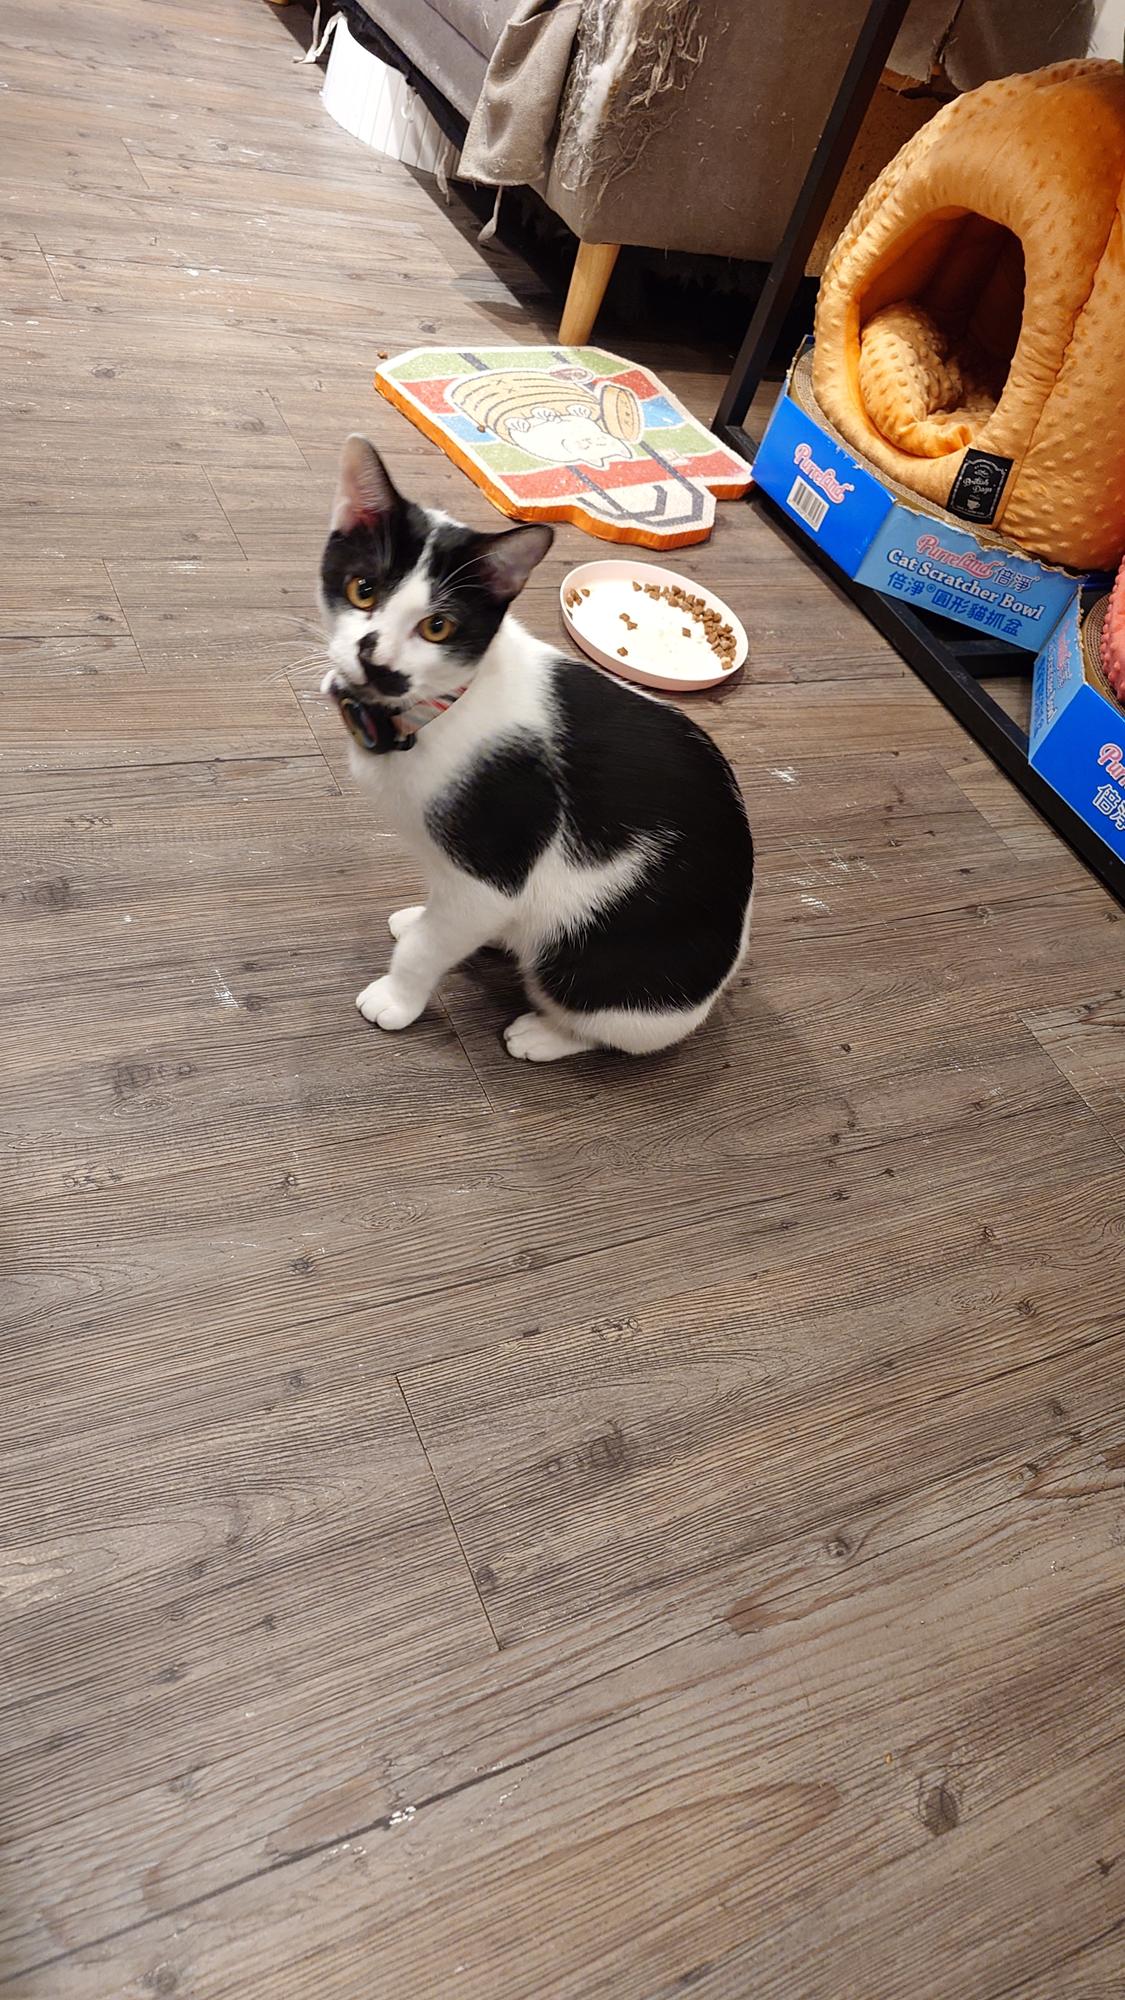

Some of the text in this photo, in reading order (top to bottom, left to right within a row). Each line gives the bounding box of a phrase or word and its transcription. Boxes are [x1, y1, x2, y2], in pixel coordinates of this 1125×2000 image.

[887, 549, 1046, 621] Cat Scratcher Bowl
